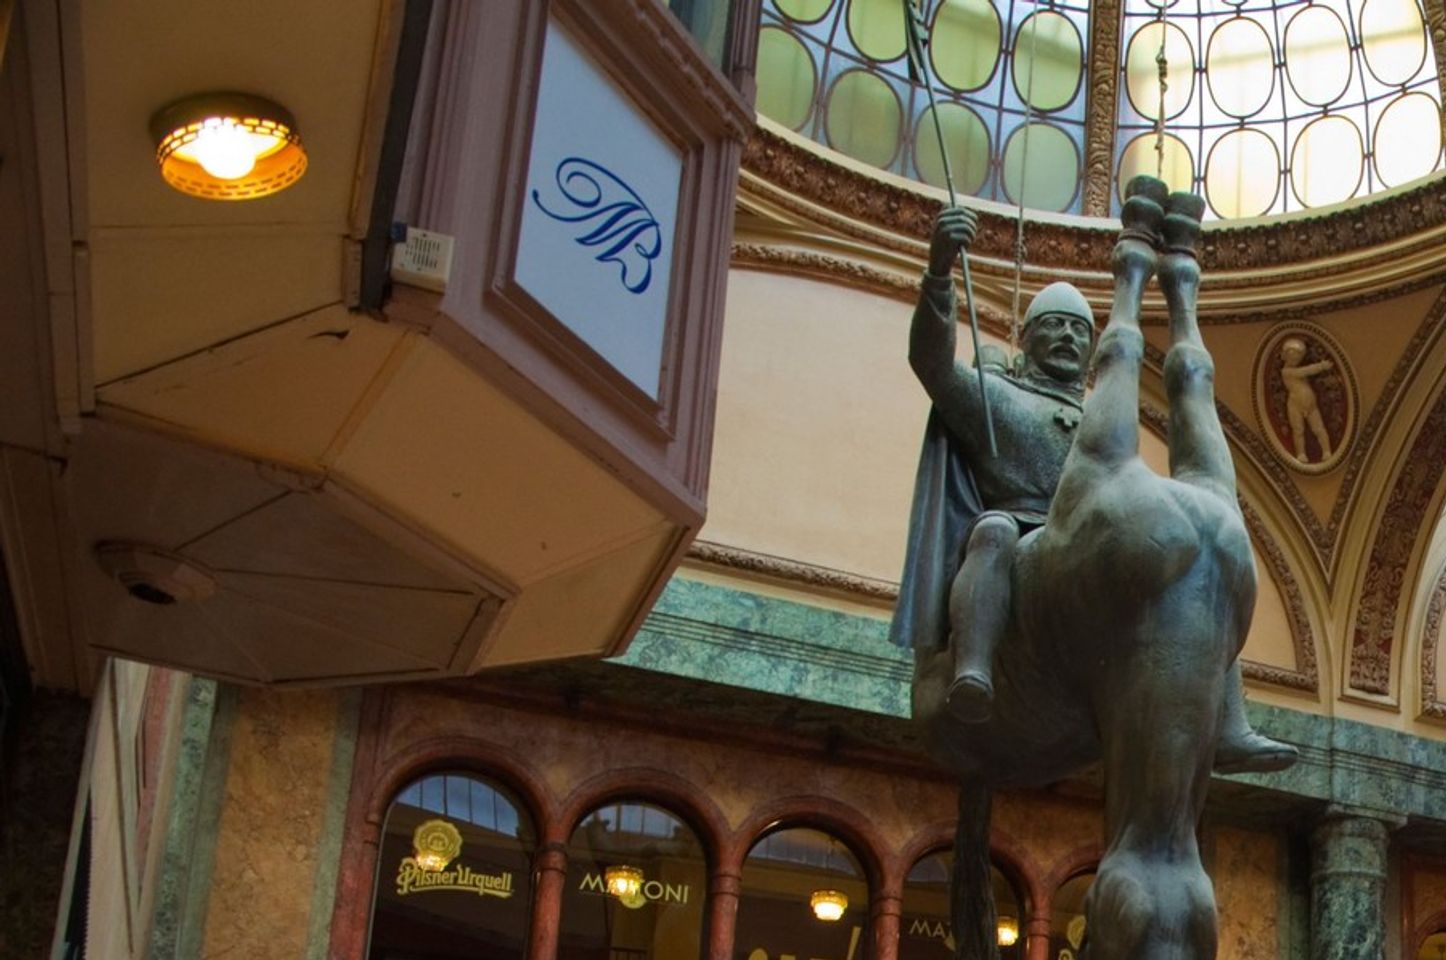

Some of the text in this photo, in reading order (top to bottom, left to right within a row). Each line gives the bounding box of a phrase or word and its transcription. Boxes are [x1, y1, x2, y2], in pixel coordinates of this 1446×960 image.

[396, 857, 512, 896] Pilsner Urquell
[579, 872, 689, 904] MONI
